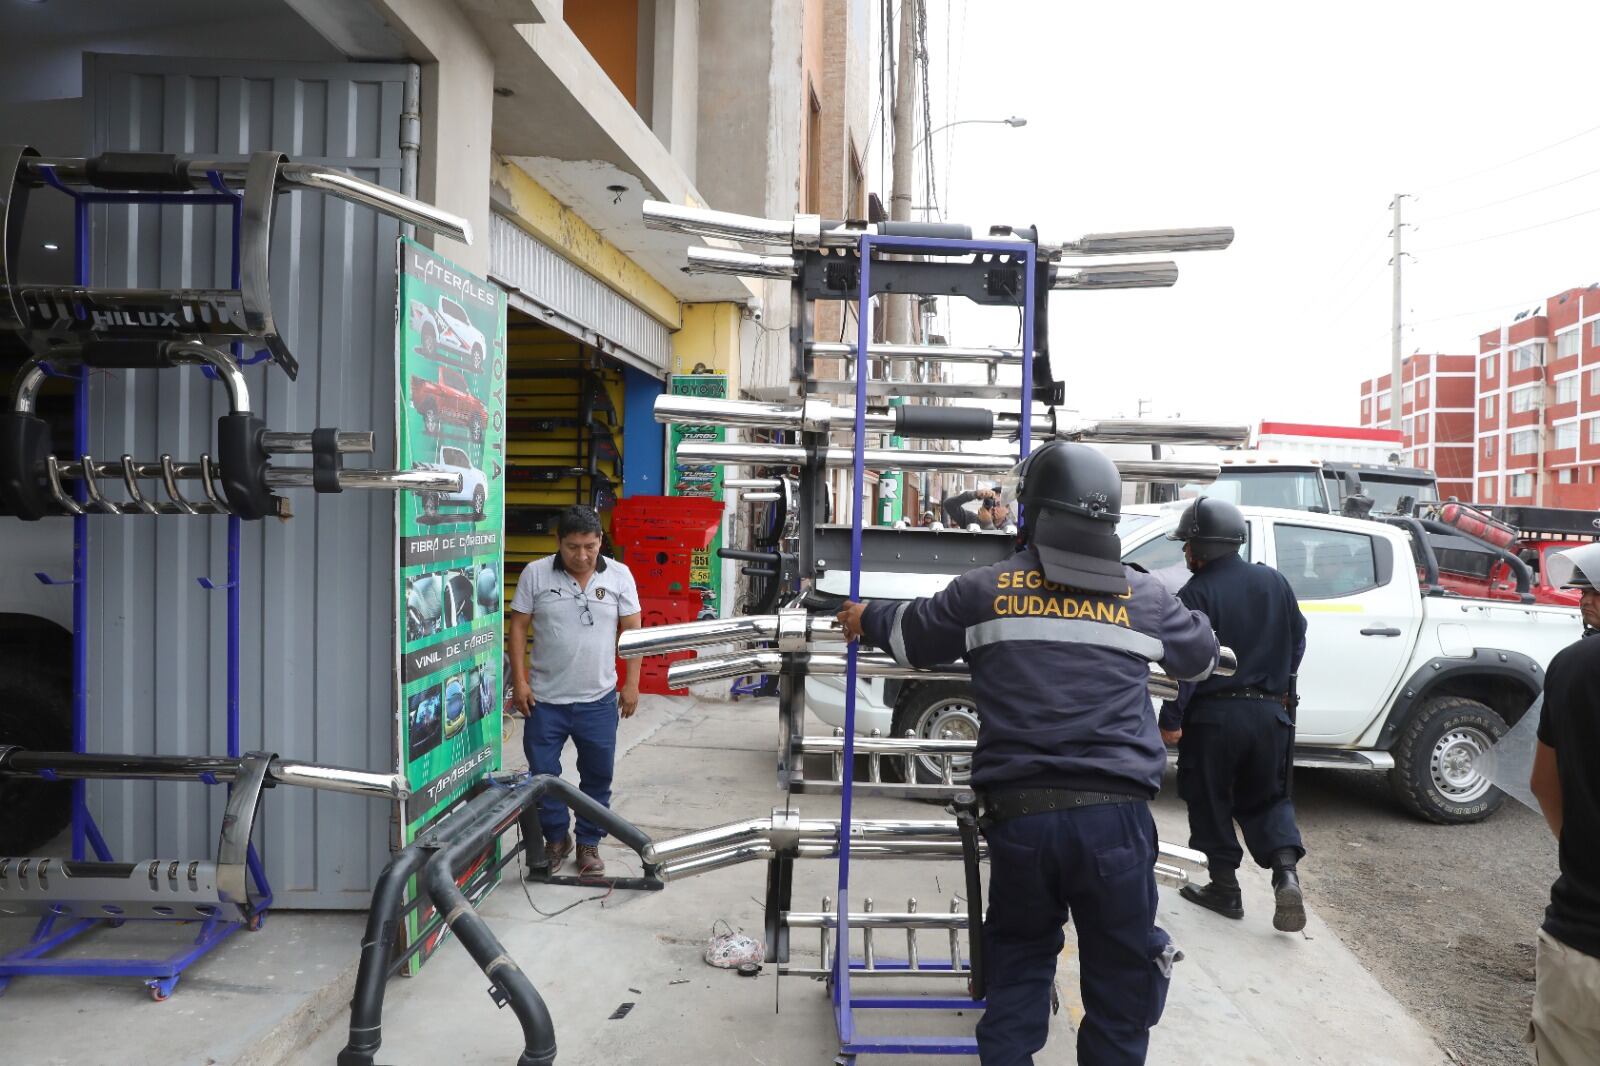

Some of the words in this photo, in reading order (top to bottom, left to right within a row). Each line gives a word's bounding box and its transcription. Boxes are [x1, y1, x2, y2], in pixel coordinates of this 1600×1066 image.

[414, 254, 495, 306] LATERALES
[92, 311, 180, 327] HILUX
[673, 384, 726, 395] TOYOTA
[492, 336, 504, 480] TOYOTA
[410, 537, 439, 555] FIBRA
[442, 538, 456, 549] DE
[459, 534, 496, 552] CARBONO
[994, 596, 1131, 627] CIUDADANA
[415, 651, 442, 669] VINIL
[446, 643, 461, 658] DE
[464, 631, 494, 651] FAROS
[427, 746, 492, 803] TAPASOLES
